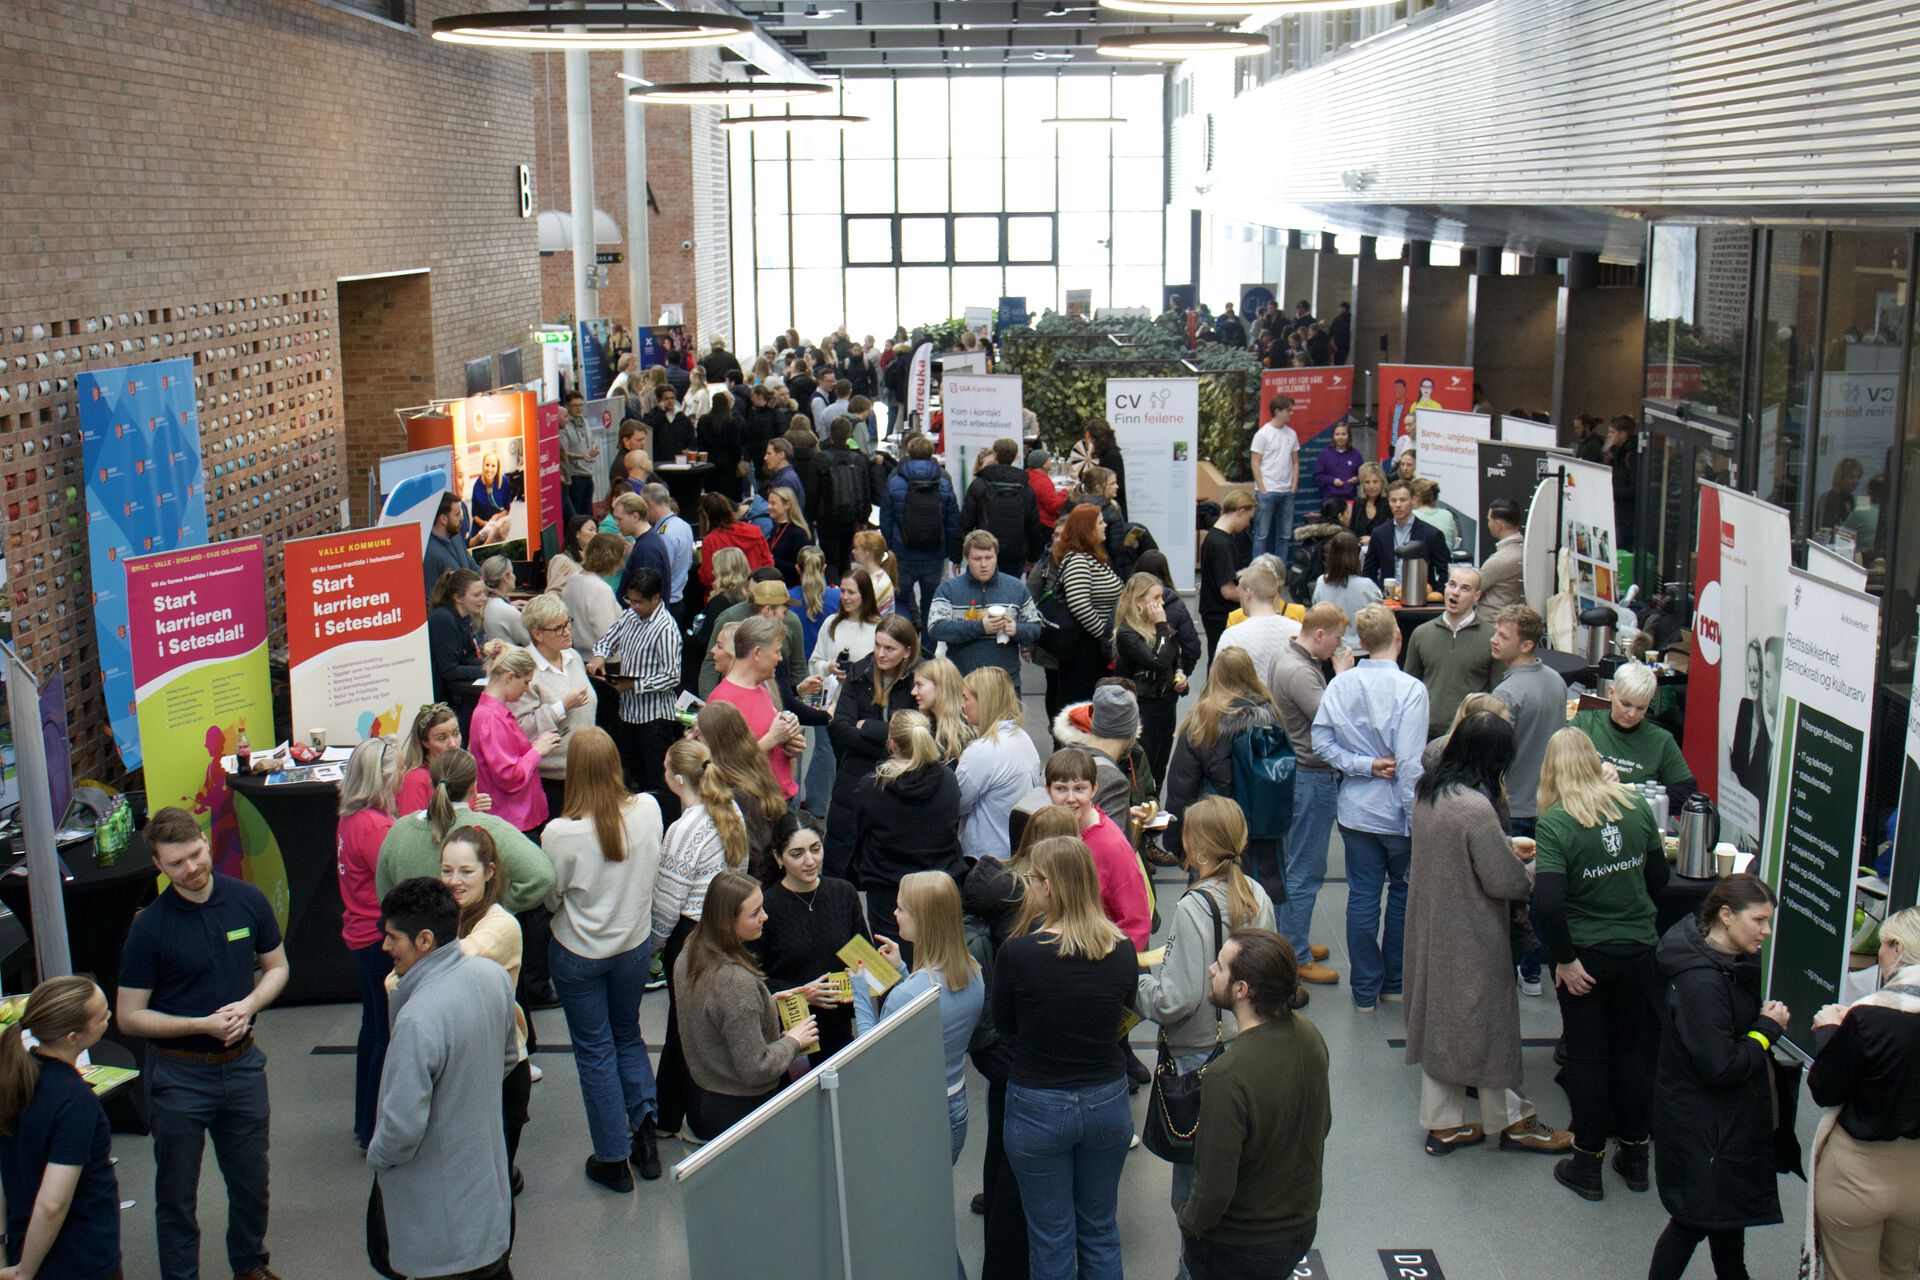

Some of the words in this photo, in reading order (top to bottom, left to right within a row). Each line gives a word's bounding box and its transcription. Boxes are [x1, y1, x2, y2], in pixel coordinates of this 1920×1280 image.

[518, 164, 533, 218] B
[1115, 394, 1142, 409] CV
[974, 408, 1001, 417] kontakt
[1114, 413, 1141, 424] Finn
[1144, 412, 1184, 424] feilene
[969, 419, 1012, 429] arbeidslivet
[1421, 442, 1430, 451] og
[1487, 467, 1506, 478] pwc
[319, 546, 345, 557] VALLE
[348, 538, 392, 552] KOMMUNE
[131, 563, 150, 573] BYKLE
[153, 559, 172, 569] VALLE
[312, 574, 354, 595] Start
[154, 590, 197, 612] Start
[313, 592, 390, 616] karrieren
[156, 608, 232, 635] karrieren
[315, 622, 320, 638] i
[325, 607, 402, 636] Setesdal!
[1841, 612, 1869, 632] Arkivverket
[158, 641, 164, 657] i
[168, 624, 245, 655] Setesdal!
[1786, 632, 1840, 670] Rettssikkerhet,
[1784, 656, 1819, 683] demokrati
[1820, 673, 1831, 691] og
[1832, 675, 1866, 703] kulturarv
[1799, 867, 1808, 880] og
[785, 996, 802, 1023] TICKET
